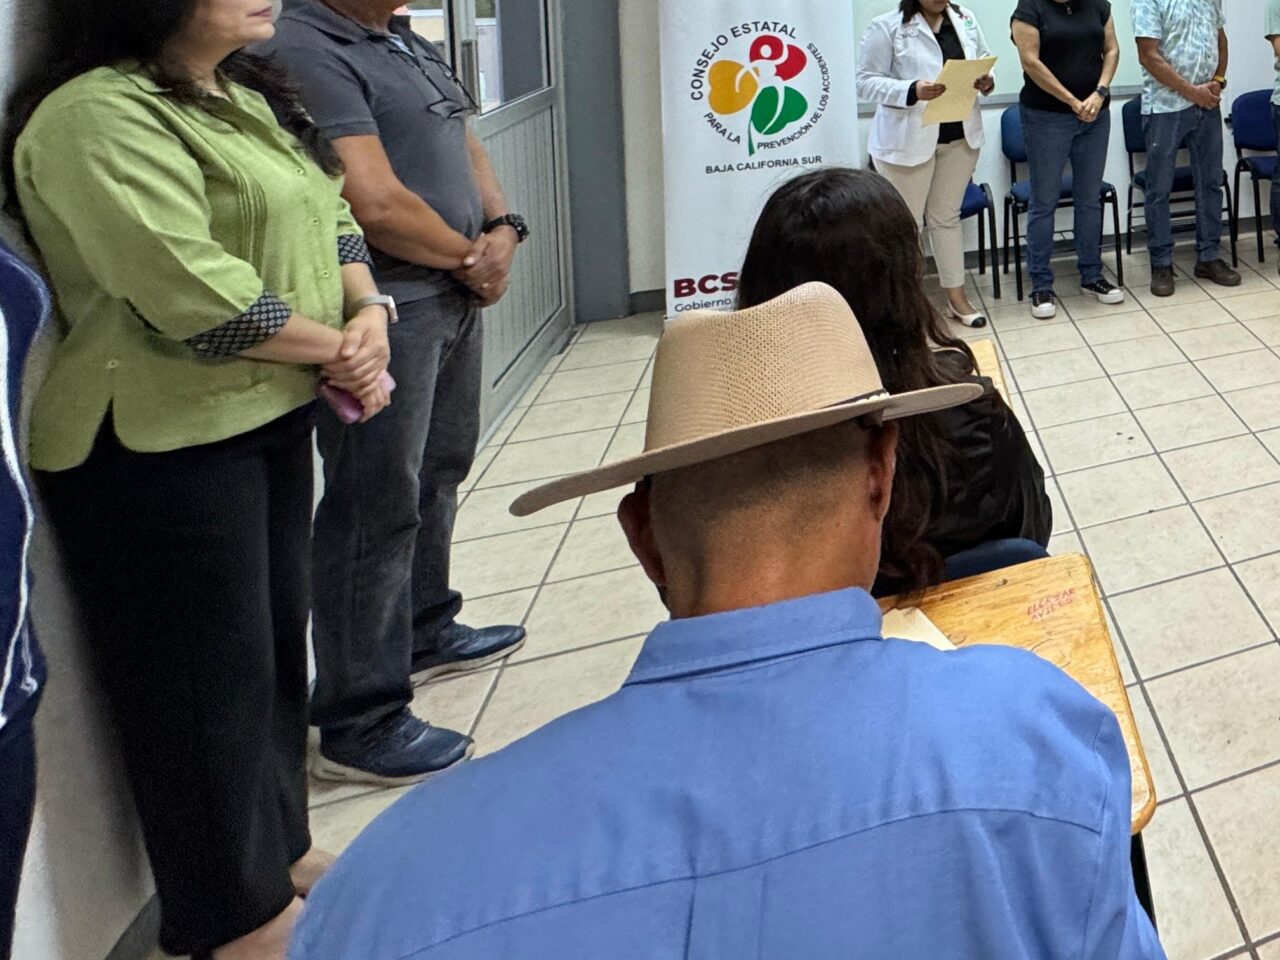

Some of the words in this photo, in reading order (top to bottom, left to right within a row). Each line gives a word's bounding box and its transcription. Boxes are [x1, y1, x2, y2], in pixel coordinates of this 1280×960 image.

[691, 34, 729, 101] CONSEJO
[730, 21, 797, 39] ESTATAL
[806, 42, 831, 94] ACCIDENTES
[817, 94, 830, 112] LOS
[703, 112, 727, 137] PARA
[810, 111, 822, 124] DE
[726, 130, 742, 145] LA
[705, 163, 735, 174] BAJA
[736, 157, 799, 171] CALIFORNIA
[801, 155, 822, 165] SUR
[674, 272, 740, 298] BCS
[674, 298, 732, 312] Gobierno
